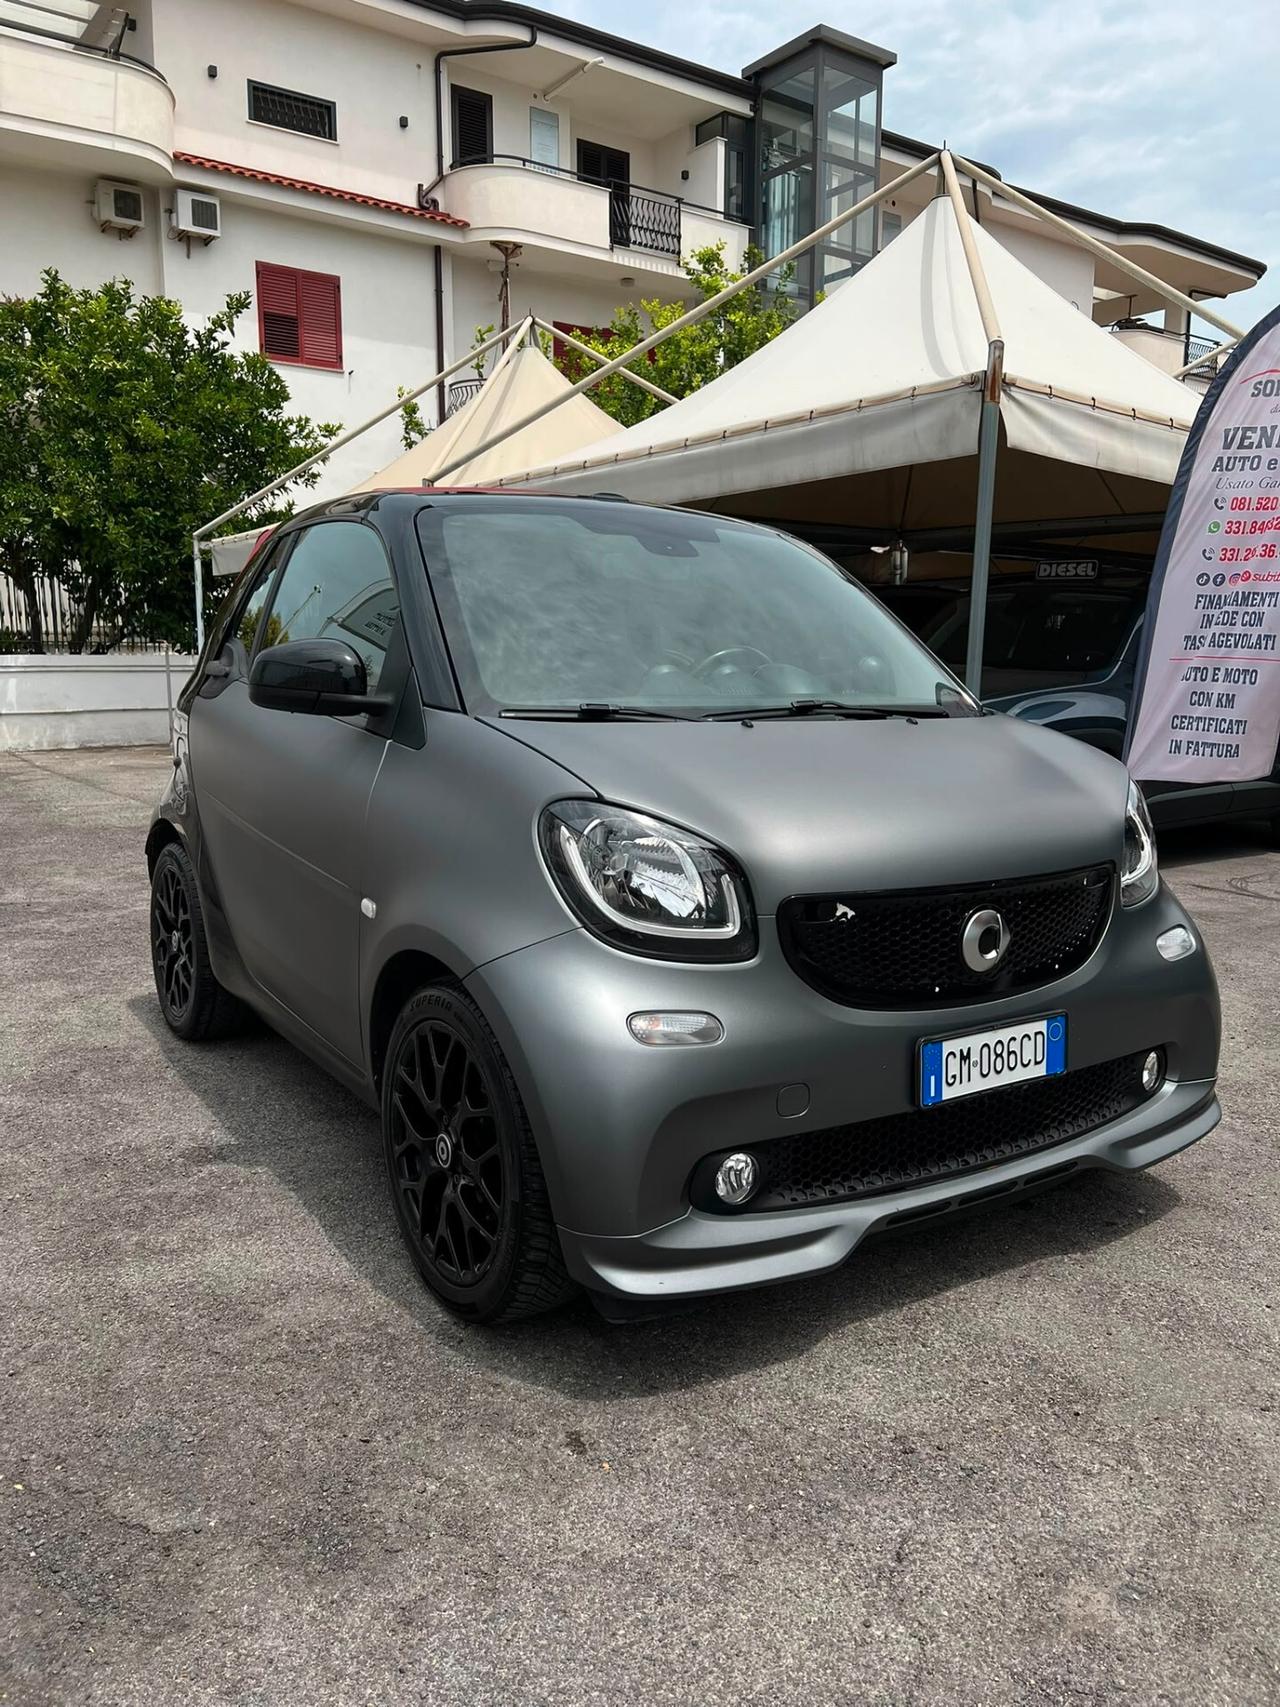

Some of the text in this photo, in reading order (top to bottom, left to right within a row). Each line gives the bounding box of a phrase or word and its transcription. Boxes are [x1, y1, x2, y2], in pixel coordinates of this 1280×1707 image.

[1222, 425, 1280, 450] VEN
[1211, 455, 1279, 472] AUTO e
[1215, 477, 1254, 490] Usato
[1039, 562, 1095, 577] DIESEL
[1200, 613, 1215, 629] IN
[1241, 611, 1265, 627] CON
[1208, 632, 1277, 651] AGEVOLATI
[1211, 667, 1221, 682] E
[1222, 667, 1259, 685] MOTO
[1189, 691, 1236, 709] CON KM
[1171, 715, 1248, 735] CERTIFICATI
[1168, 739, 1240, 758] IN FATTURA
